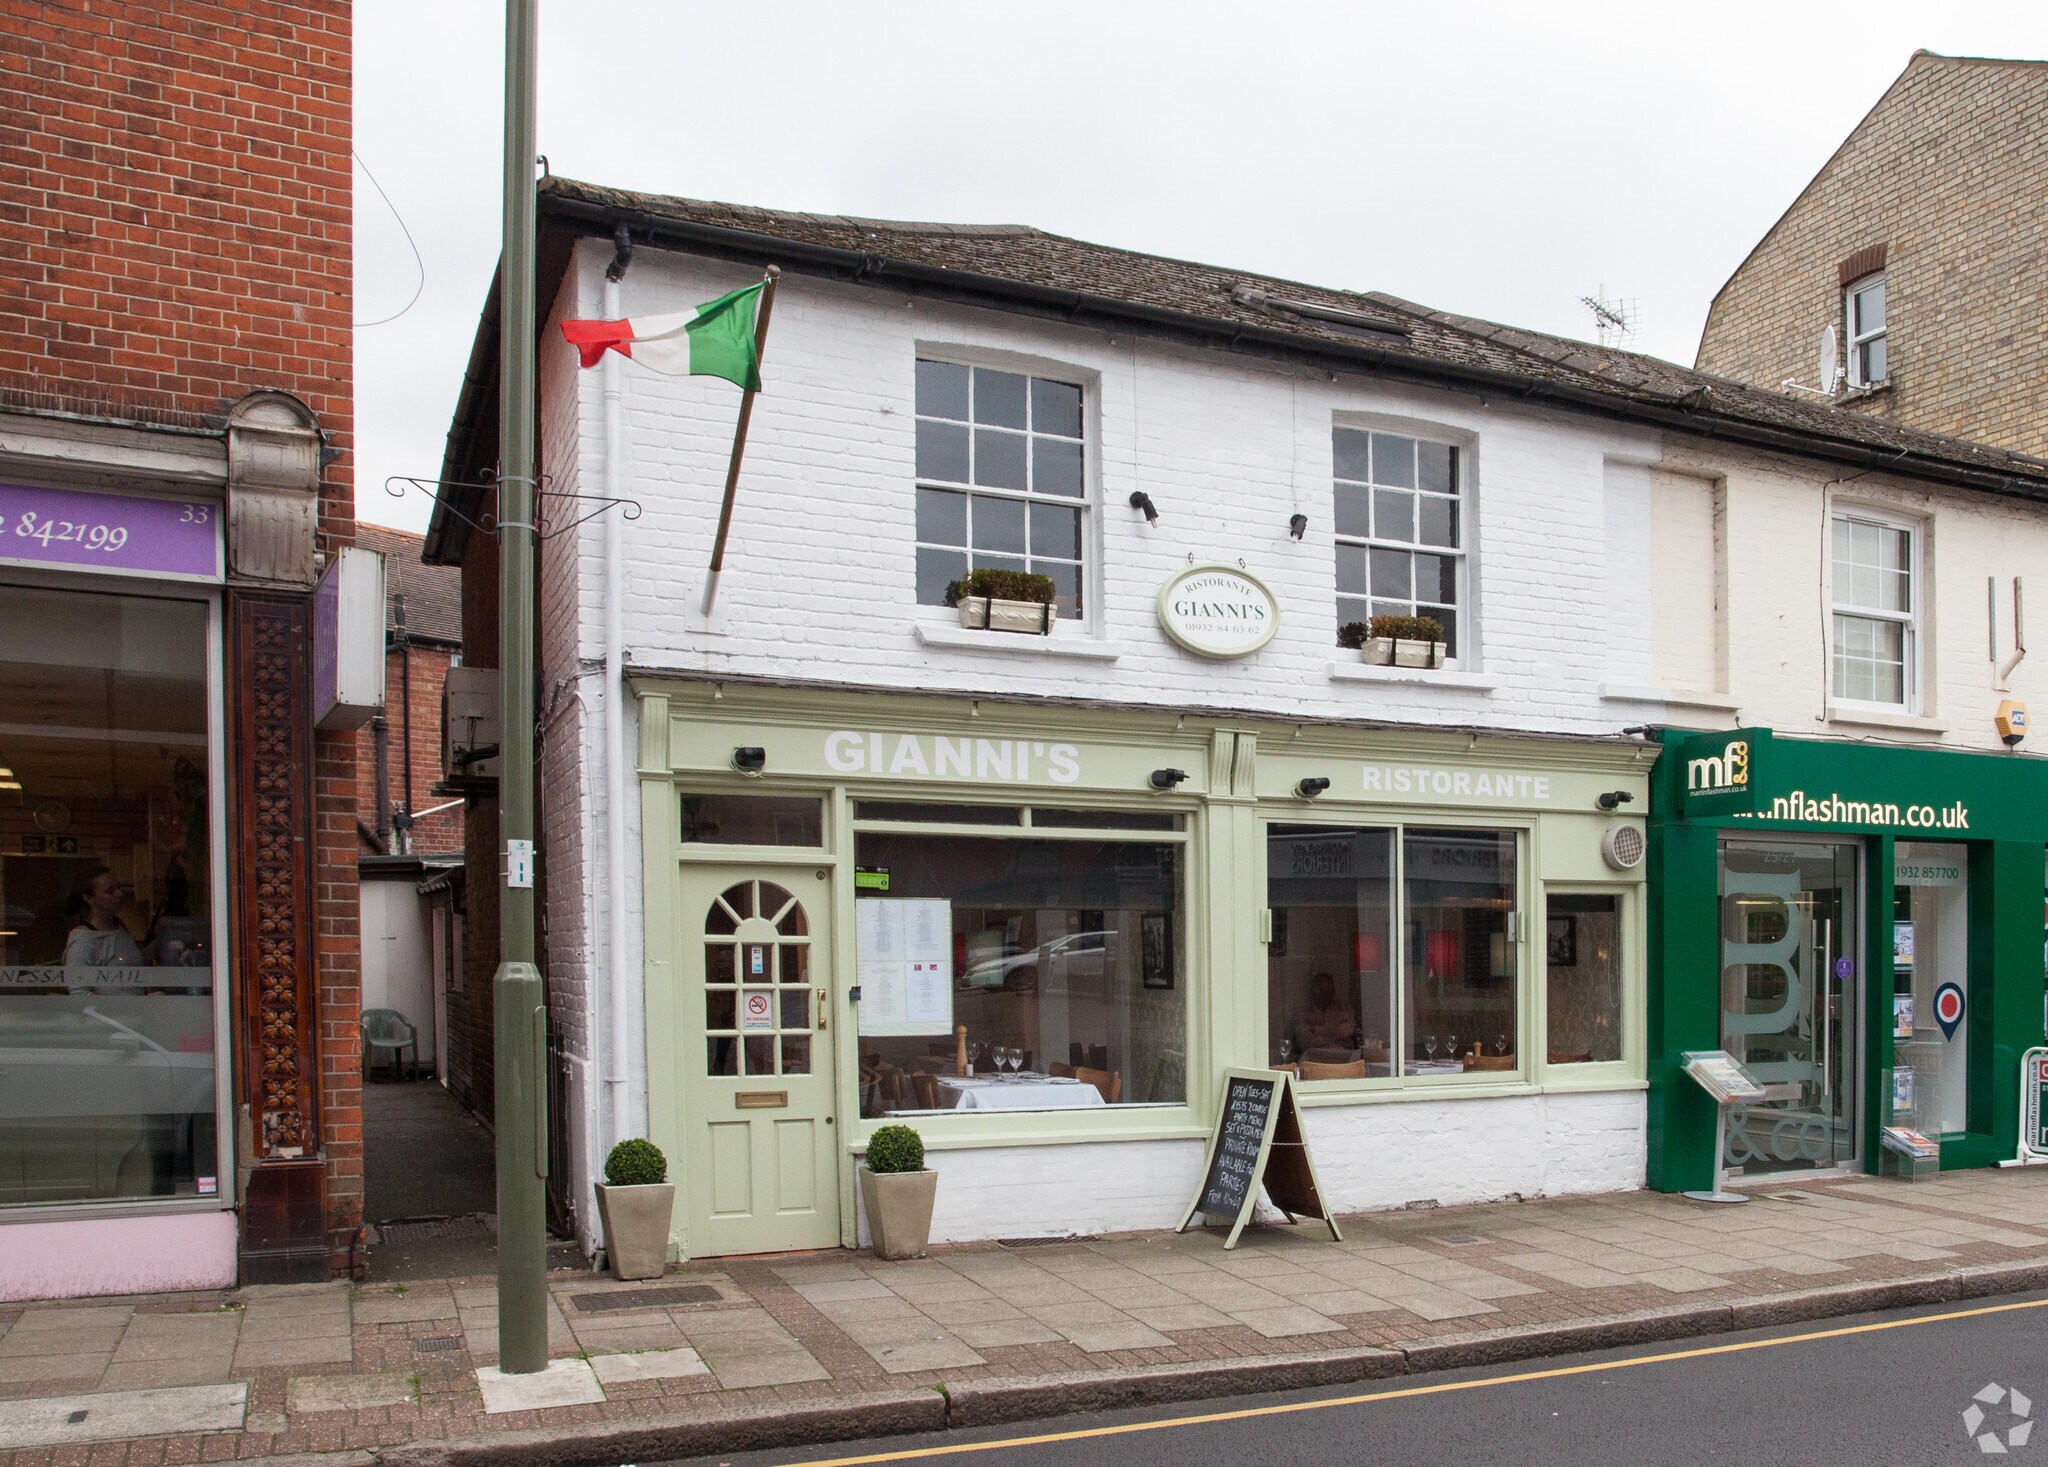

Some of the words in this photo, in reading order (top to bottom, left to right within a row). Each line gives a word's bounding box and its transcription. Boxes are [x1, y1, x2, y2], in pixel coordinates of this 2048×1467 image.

[179, 504, 209, 524] 33
[15, 511, 128, 552] 842199
[1185, 578, 1253, 597] RISTORANTE
[1174, 600, 1265, 620] GIANNI'S
[1185, 623, 1213, 632] 01932
[1216, 624, 1229, 633] 84
[1232, 625, 1245, 634] 63
[1248, 625, 1260, 634] 62
[824, 730, 1080, 784] GIANNI'S
[1362, 766, 1550, 800] RISTORANTE
[1689, 785, 1748, 797] martinflashman.co.uk
[1733, 790, 1969, 829] nflashman.co.uk
[1922, 866, 1959, 879] 857700
[95, 969, 143, 984] NAIL
[1232, 1084, 1247, 1098] OPEN
[2030, 1060, 2038, 1147] martinflashman.co.uk
